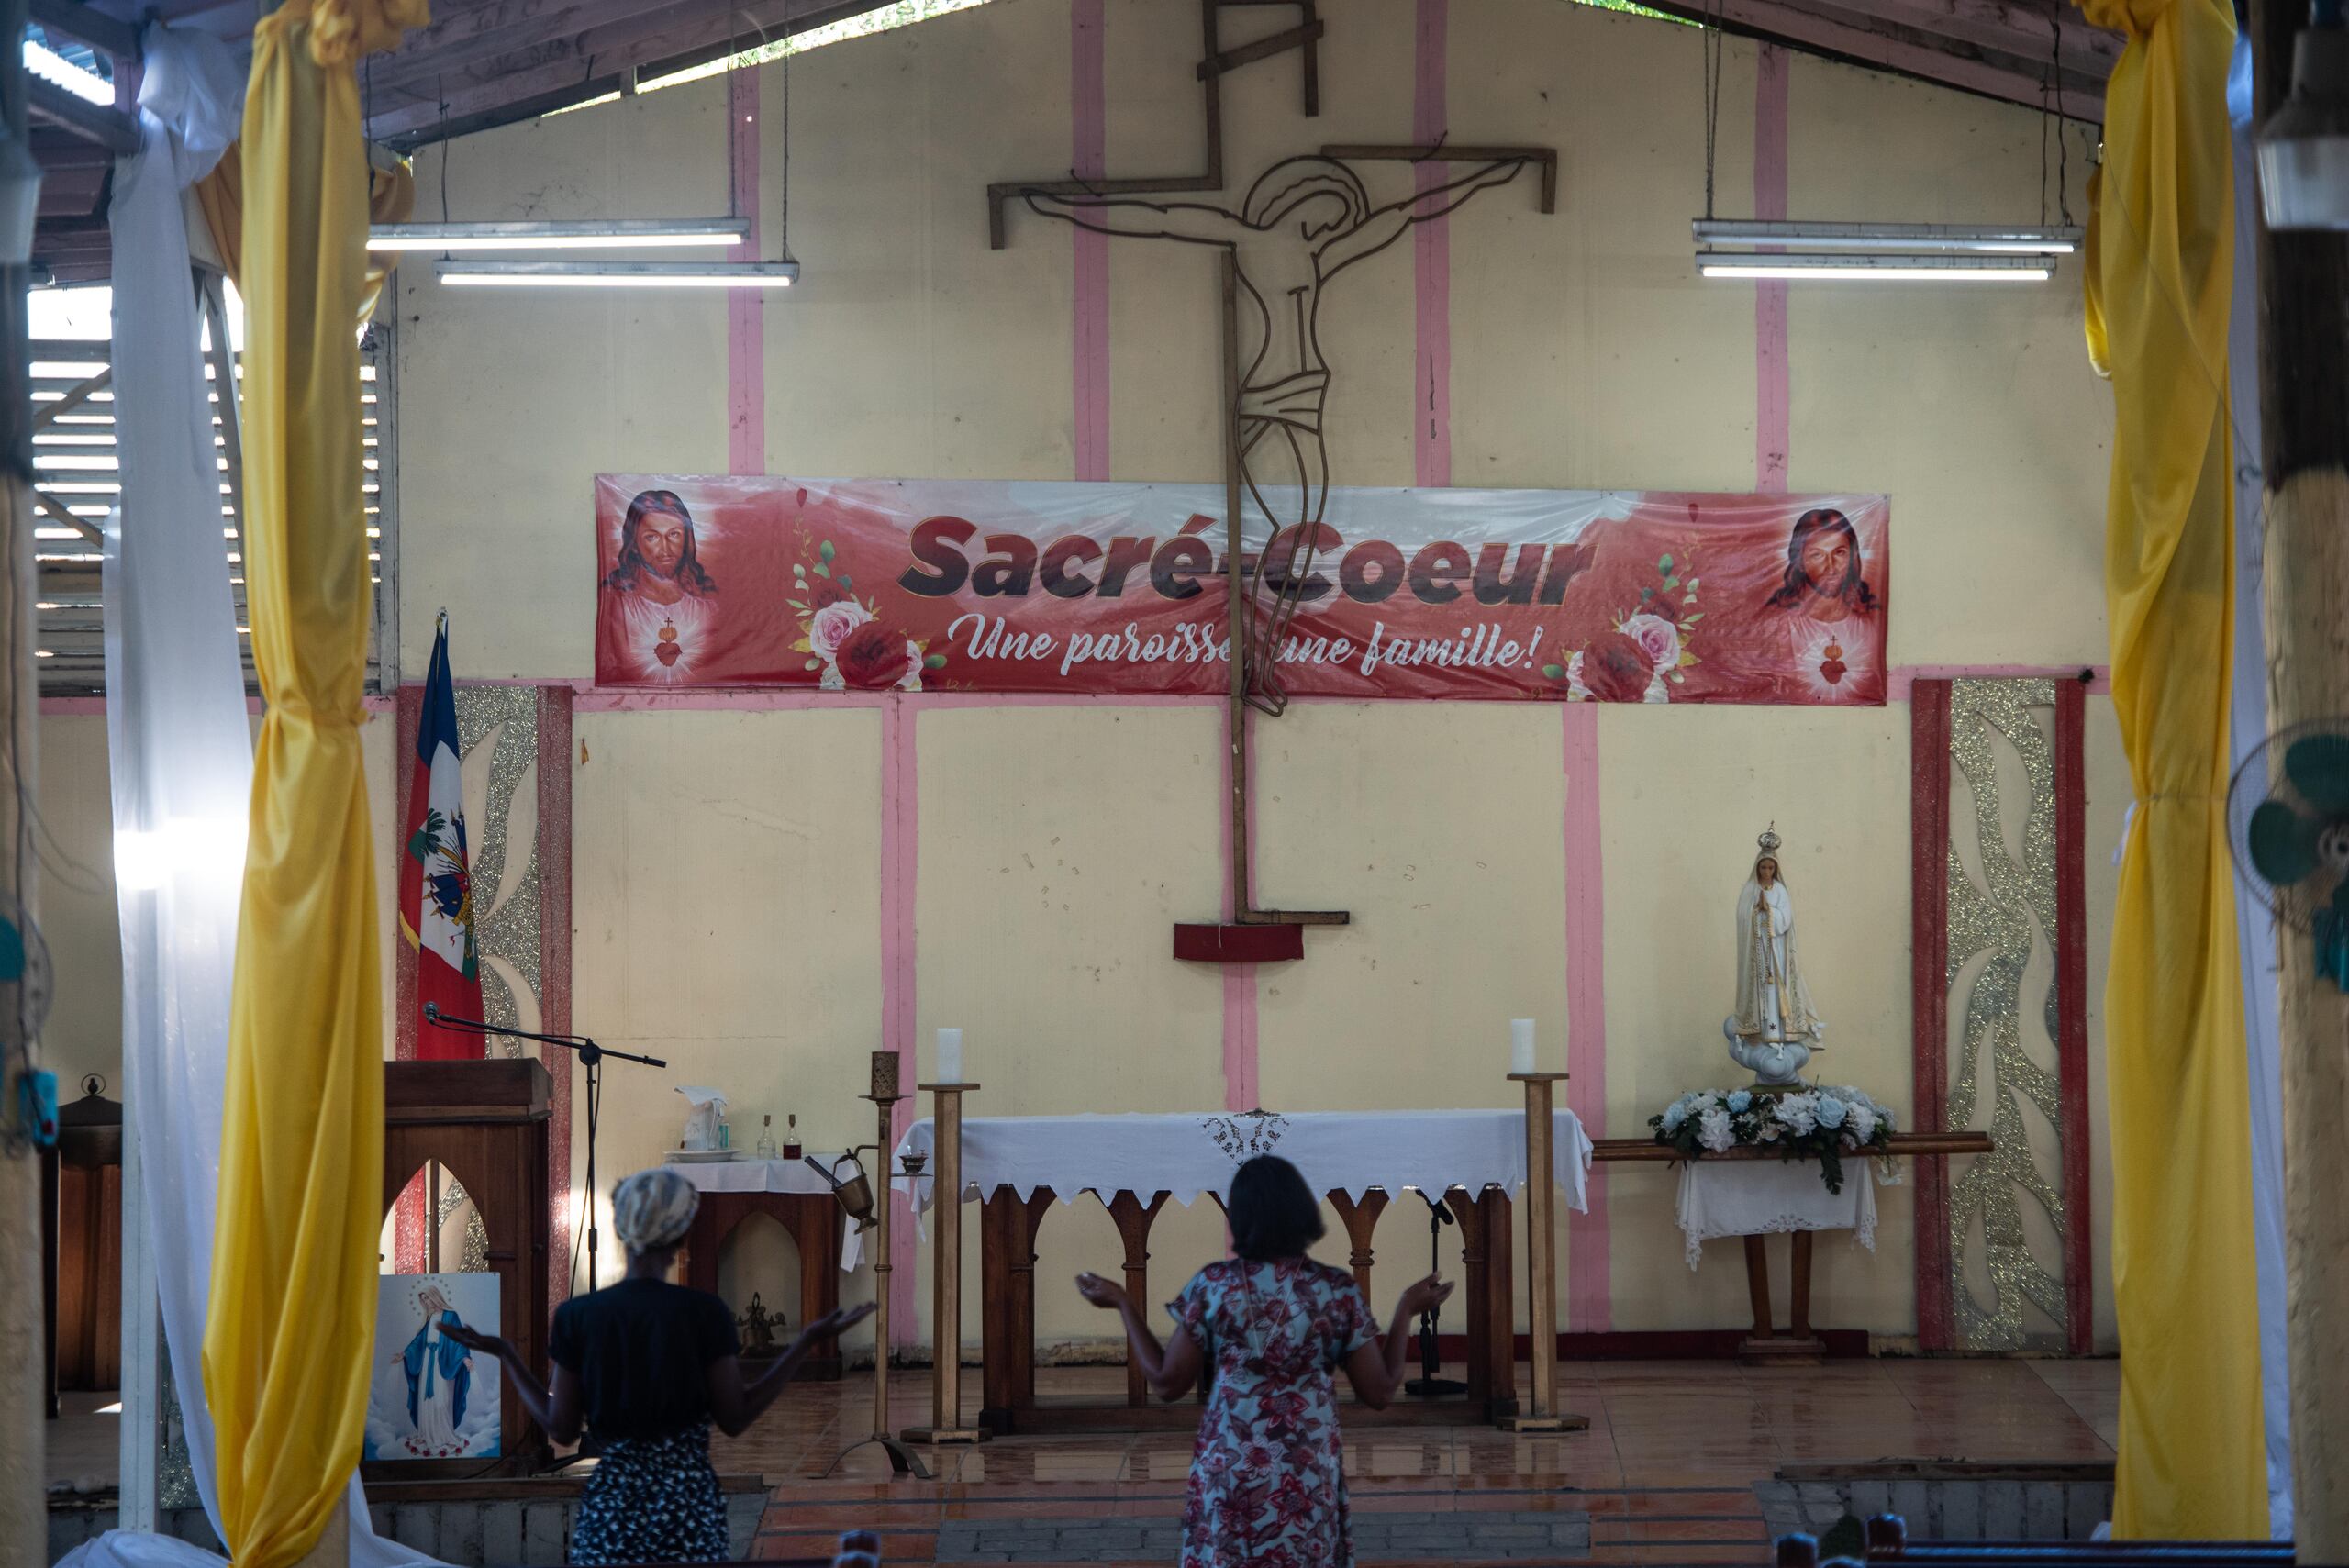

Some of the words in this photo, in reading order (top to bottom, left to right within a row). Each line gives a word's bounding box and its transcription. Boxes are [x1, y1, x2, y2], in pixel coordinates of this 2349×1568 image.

[896, 513, 1598, 606] Sacré-Coeur
[948, 613, 1059, 661] Une
[1271, 635, 1356, 664] une
[1359, 621, 1544, 677] famille!
